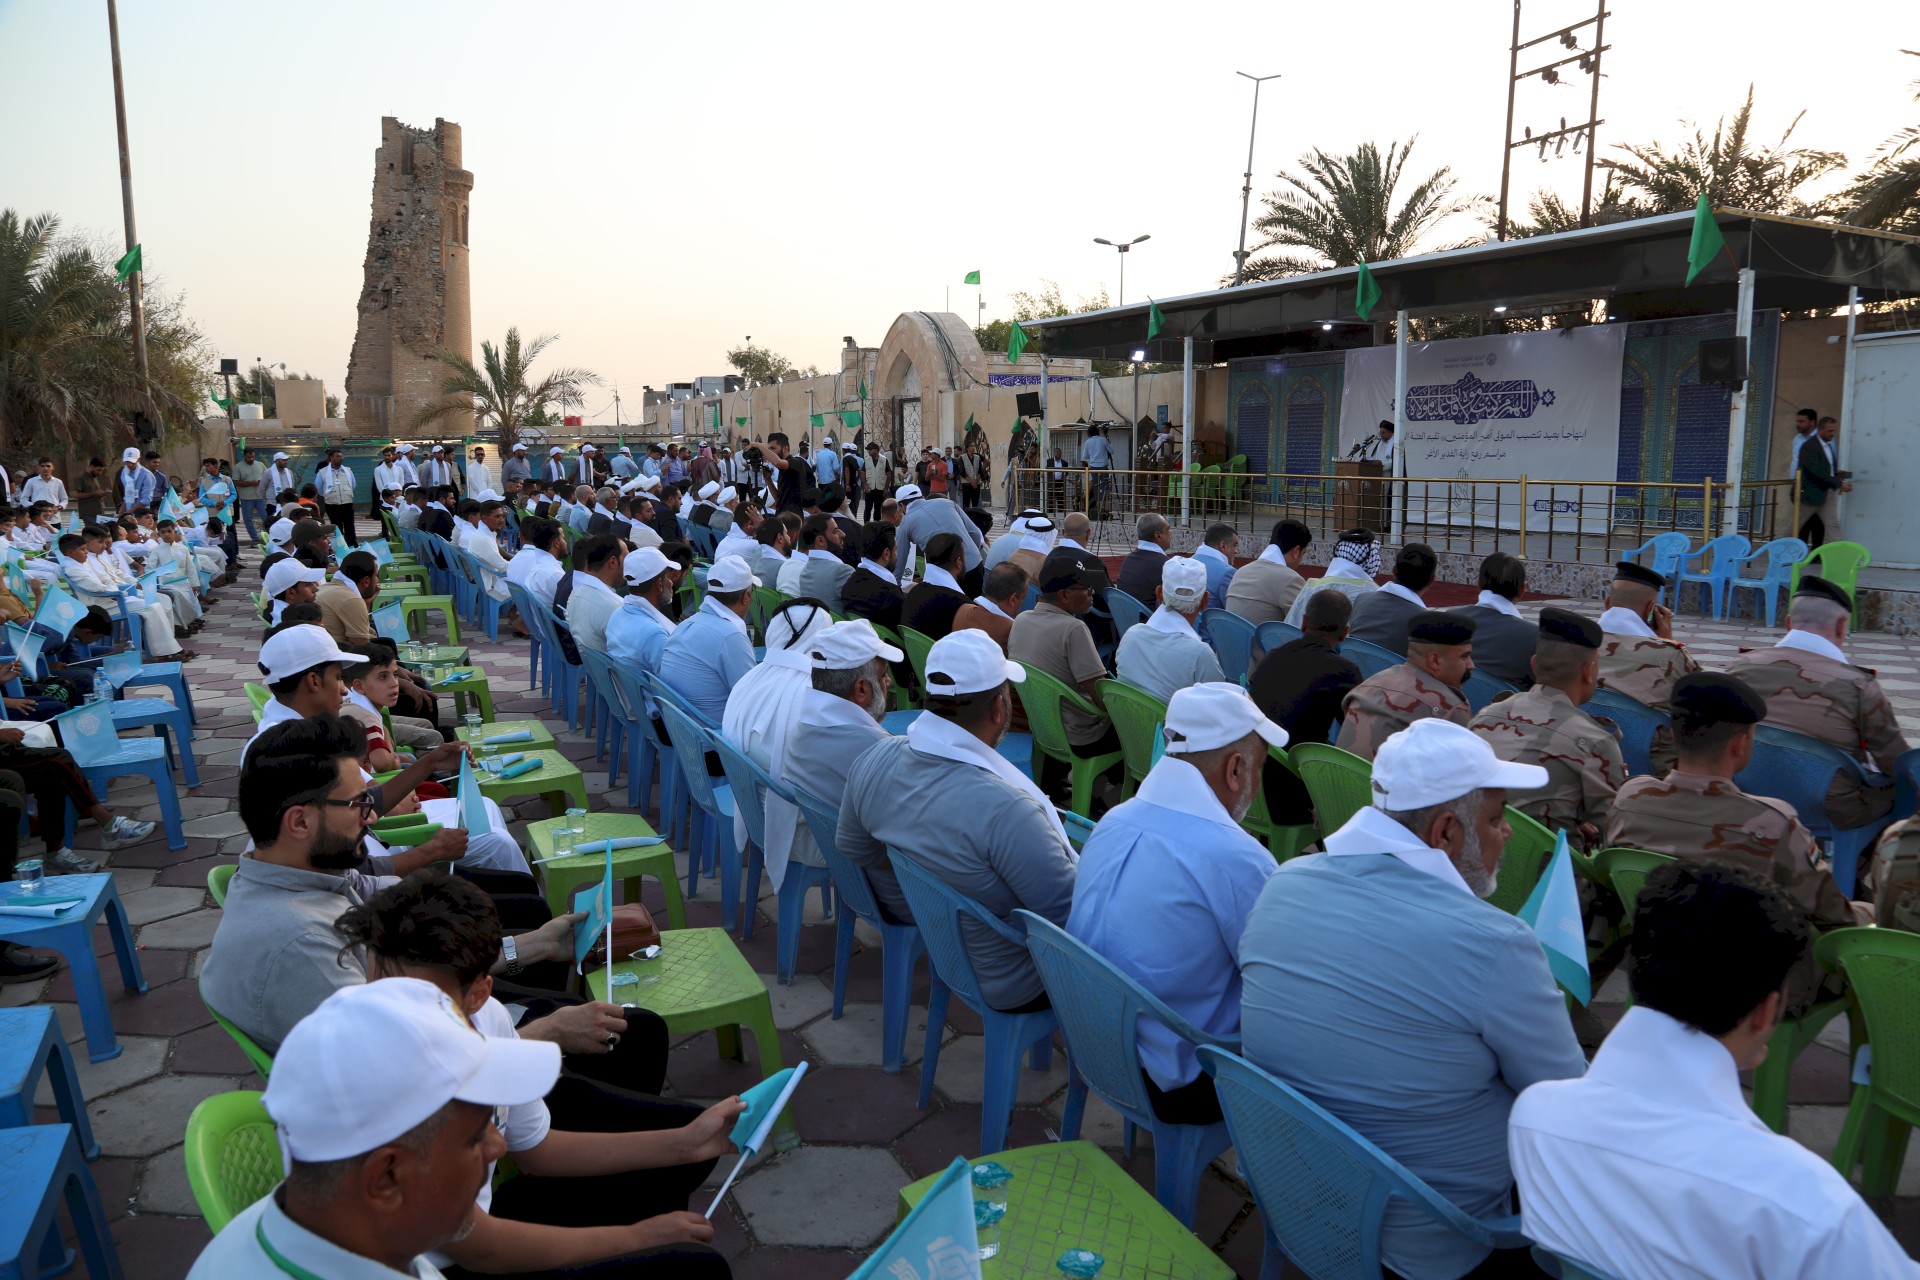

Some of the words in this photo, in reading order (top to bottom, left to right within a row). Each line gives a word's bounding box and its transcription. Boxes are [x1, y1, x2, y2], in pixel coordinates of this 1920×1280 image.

[1478, 428, 1493, 442] أمير
[1515, 430, 1542, 441] تنصيب
[1543, 431, 1560, 441] بعيد
[1440, 448, 1458, 460] الغدير
[1459, 448, 1470, 460] راية
[1470, 448, 1482, 462] رفع
